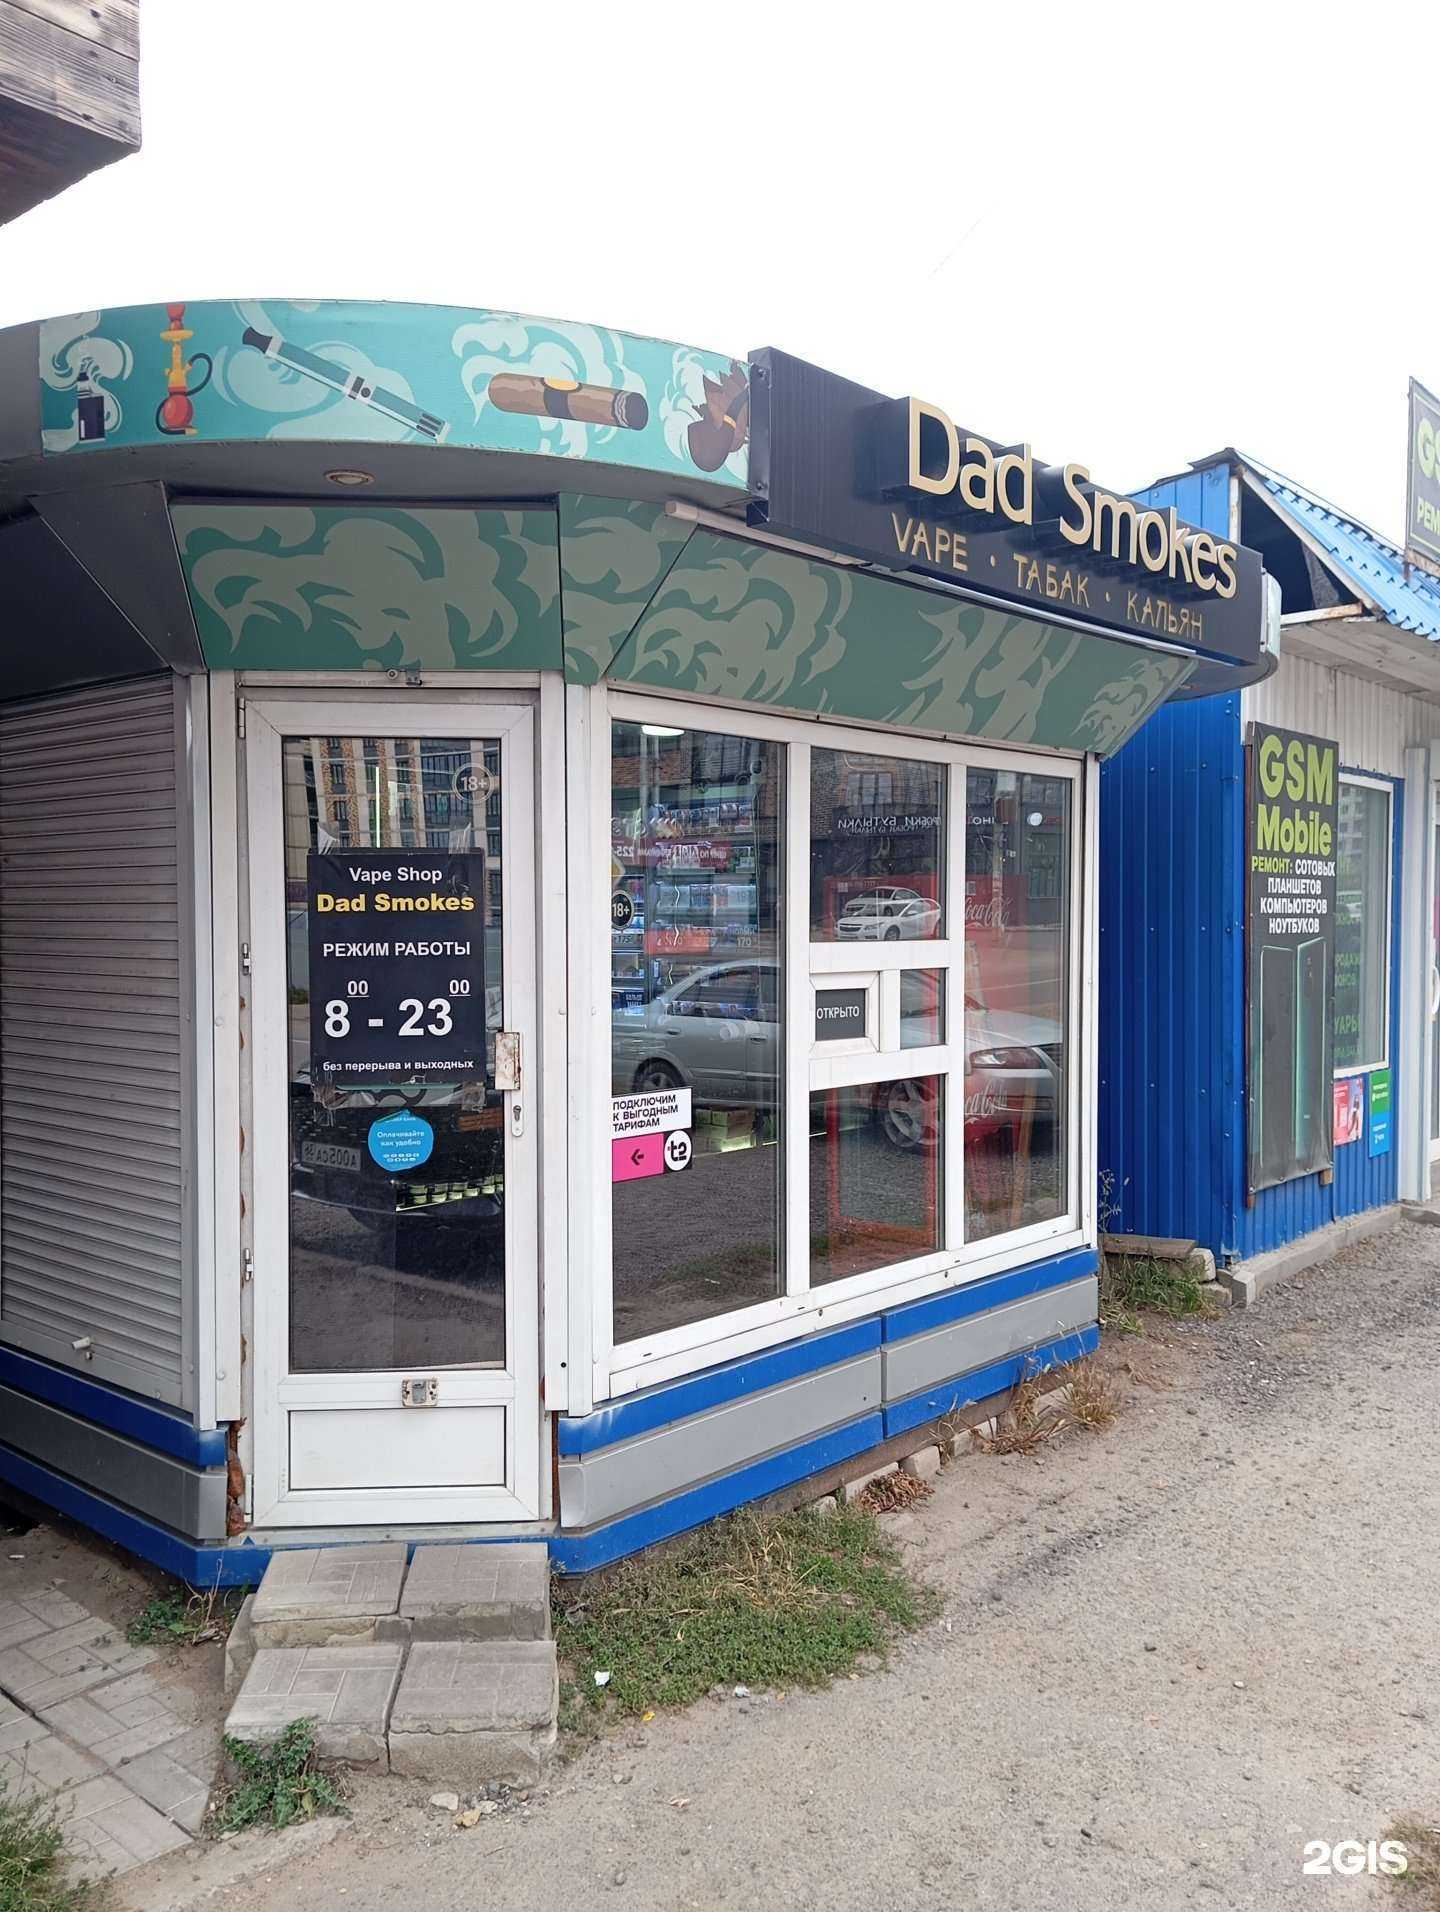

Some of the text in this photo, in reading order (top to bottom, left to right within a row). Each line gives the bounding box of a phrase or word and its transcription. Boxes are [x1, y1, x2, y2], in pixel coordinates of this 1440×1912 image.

[1418, 417, 1440, 485] G
[909, 396, 1237, 599] Dad Smokes
[891, 512, 968, 572] VAPE
[1013, 553, 1089, 608] ТАБАК
[1127, 591, 1202, 641] КАЛЬЯН
[1259, 734, 1333, 805] GSM
[460, 775, 488, 792] 18+
[1257, 803, 1332, 857] Mobile
[349, 866, 443, 884] Vape Shop
[1252, 856, 1293, 874] РЕМОНТ:
[1295, 859, 1336, 877] СОТОВЫХ
[1267, 877, 1322, 895] ПЛАНШЕТОВ
[317, 893, 475, 912] Dad Smokes
[612, 902, 630, 917] 18+
[1260, 898, 1328, 915] КОМПЬЮТЕРОВ
[1269, 917, 1320, 935] НОУТБУКОВ
[323, 941, 471, 958] РЕЖИМ РАБОТЫ
[324, 999, 351, 1038] 8
[347, 980, 370, 998] 00
[399, 998, 453, 1038] 23
[449, 979, 471, 998] 00
[816, 1005, 860, 1021] ОТКРЫТО
[323, 1059, 474, 1074] без перерыва и выходных
[613, 1094, 676, 1110] ПОДКЛЮЧИМ
[613, 1105, 679, 1122] К ВЫГОДНЫМ
[613, 1118, 660, 1132] ТАРИФАМ
[377, 1130, 425, 1139] Оплачивайте
[381, 1138, 421, 1149] как удобно
[667, 1140, 688, 1162] t2
